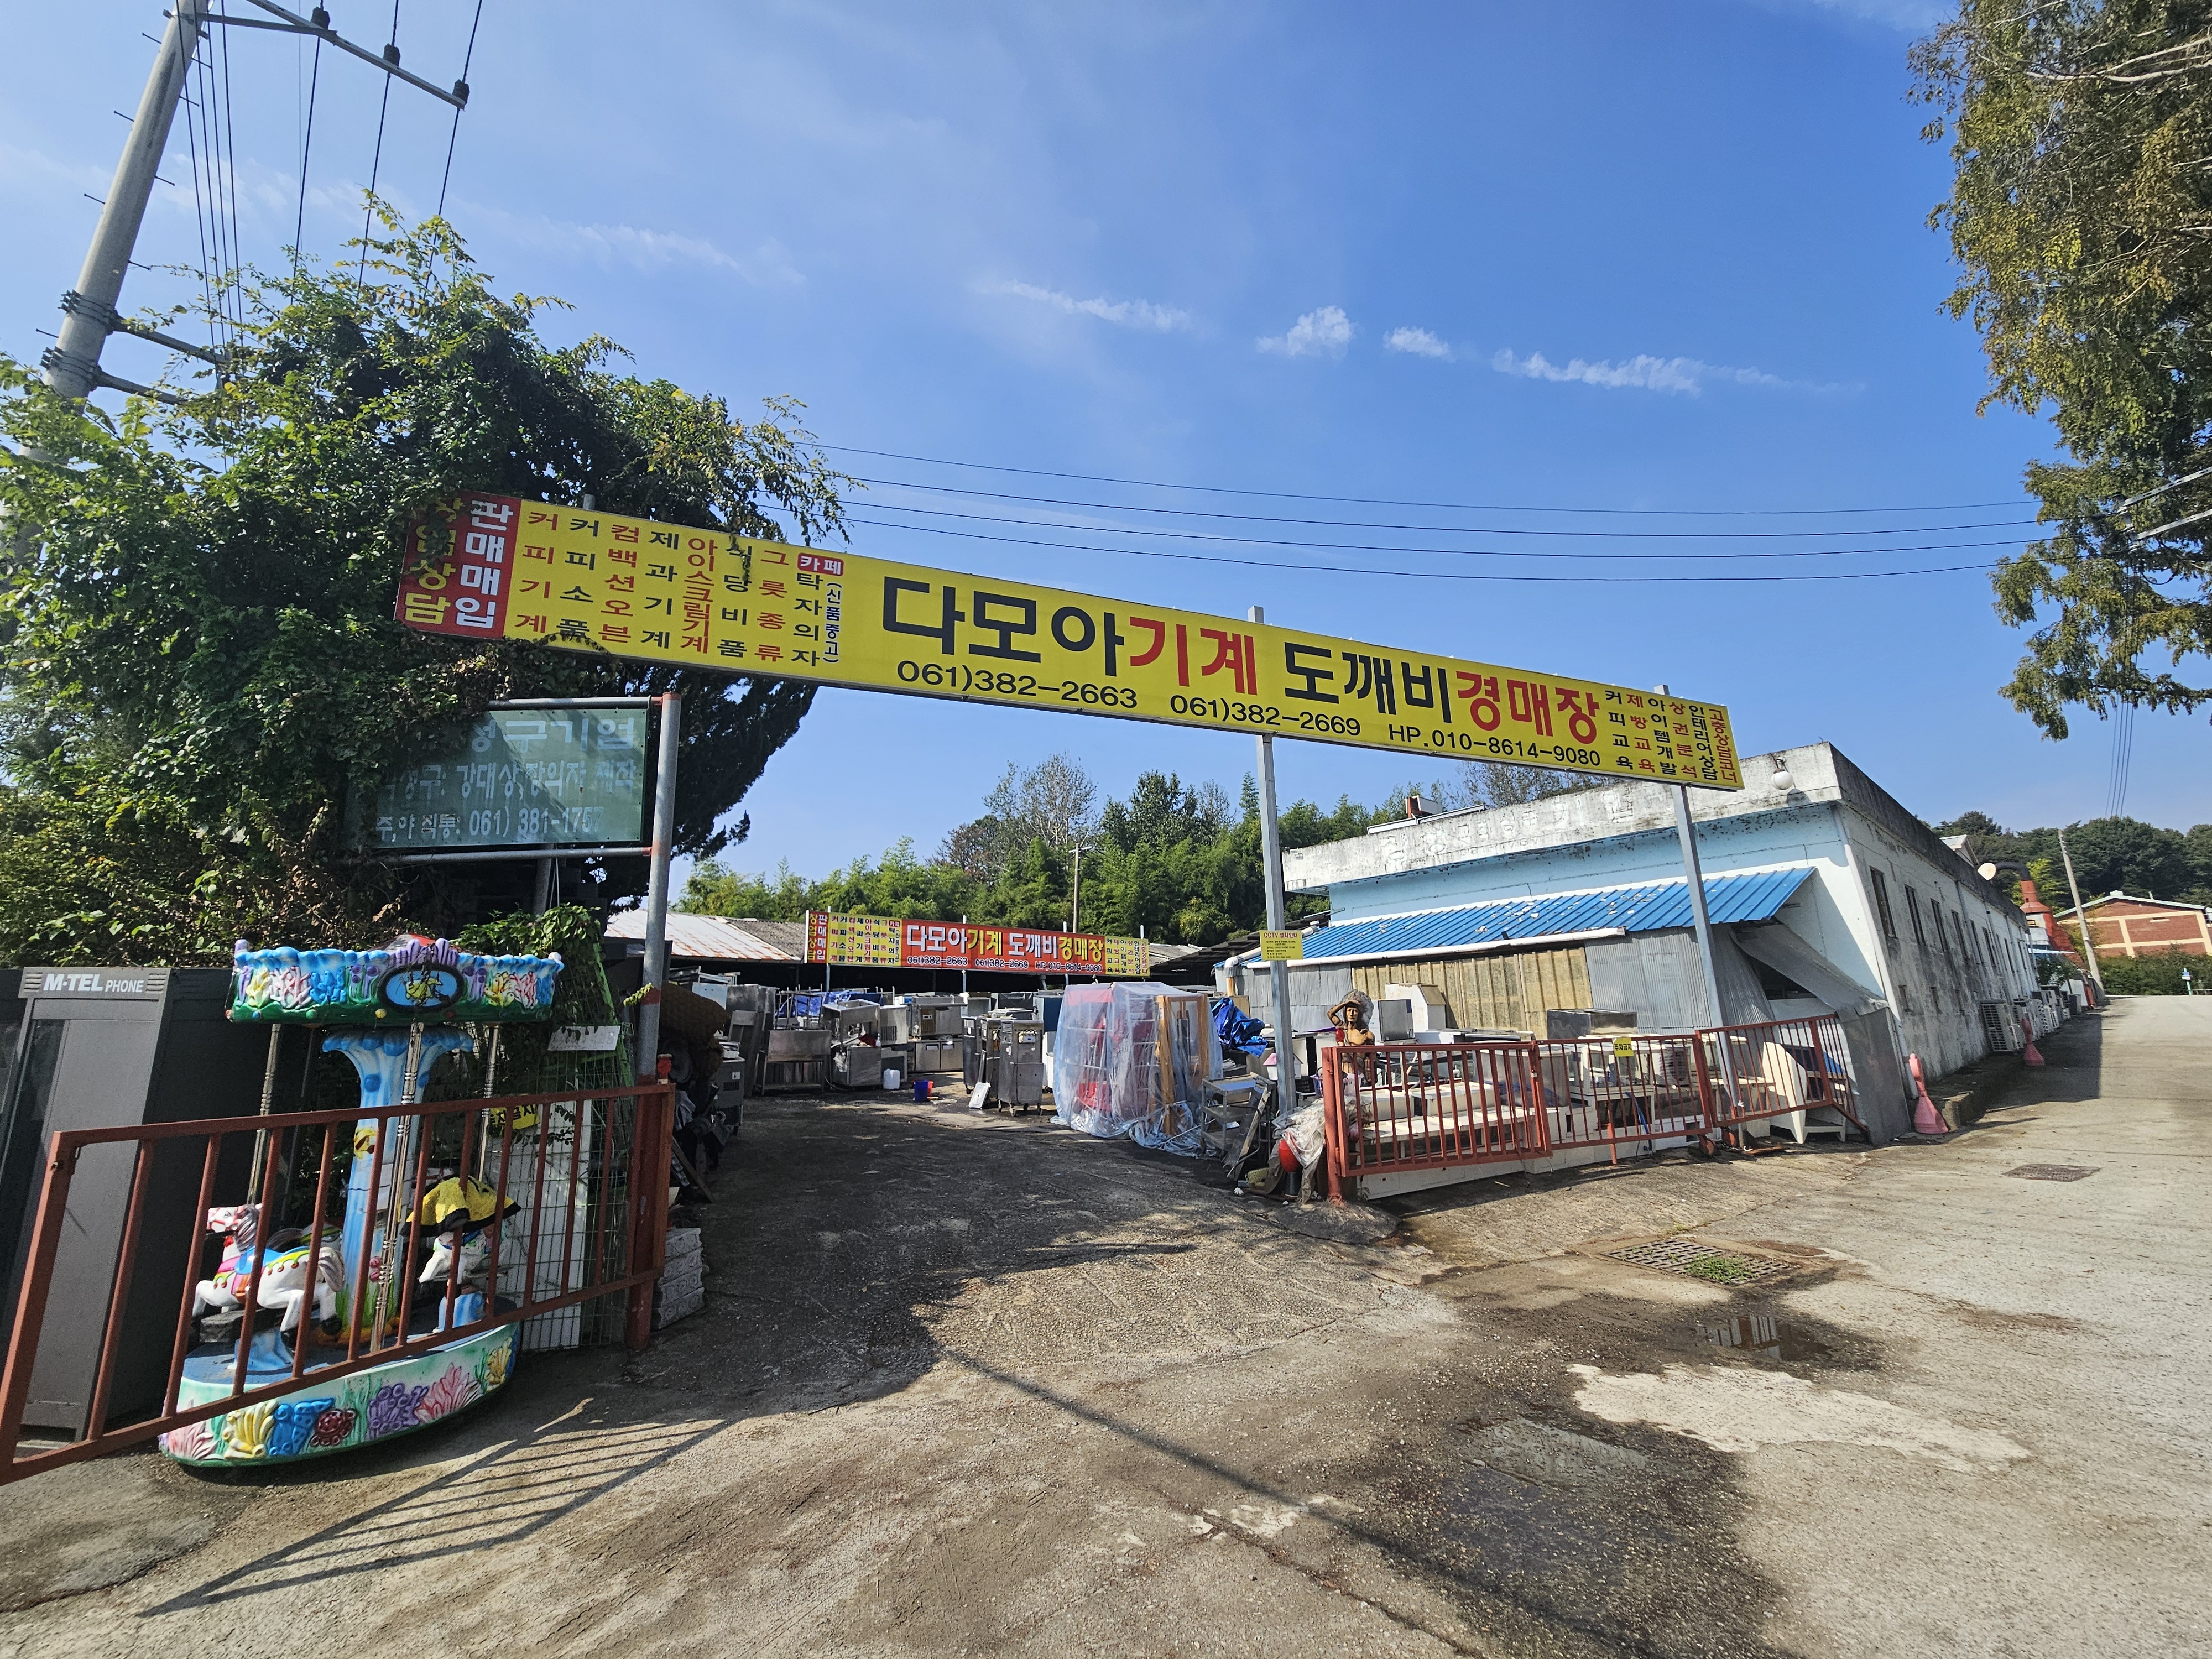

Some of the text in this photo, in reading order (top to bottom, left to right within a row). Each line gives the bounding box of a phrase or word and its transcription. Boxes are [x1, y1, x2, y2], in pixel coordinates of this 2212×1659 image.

[455, 500, 513, 629] 판매매입
[515, 512, 559, 633] 커피기계
[640, 531, 679, 649] 제과기계
[680, 538, 718, 654] 아이스크림기계
[800, 555, 842, 575] 카페
[755, 550, 789, 662] 그릇종류
[791, 573, 823, 666] 탁자의자
[898, 660, 1138, 708] 061)382-2663
[1170, 695, 1360, 735] 061)382-2669
[1605, 690, 1633, 769] 커피교육
[1626, 694, 1655, 773] 제빵교육
[1648, 698, 1677, 775] 아이템개발
[1689, 705, 1717, 780] 인테리어상담
[105, 980, 144, 992] PHONE
[907, 956, 968, 965] 061)382-2663
[975, 959, 1029, 968] 061)382-2669
